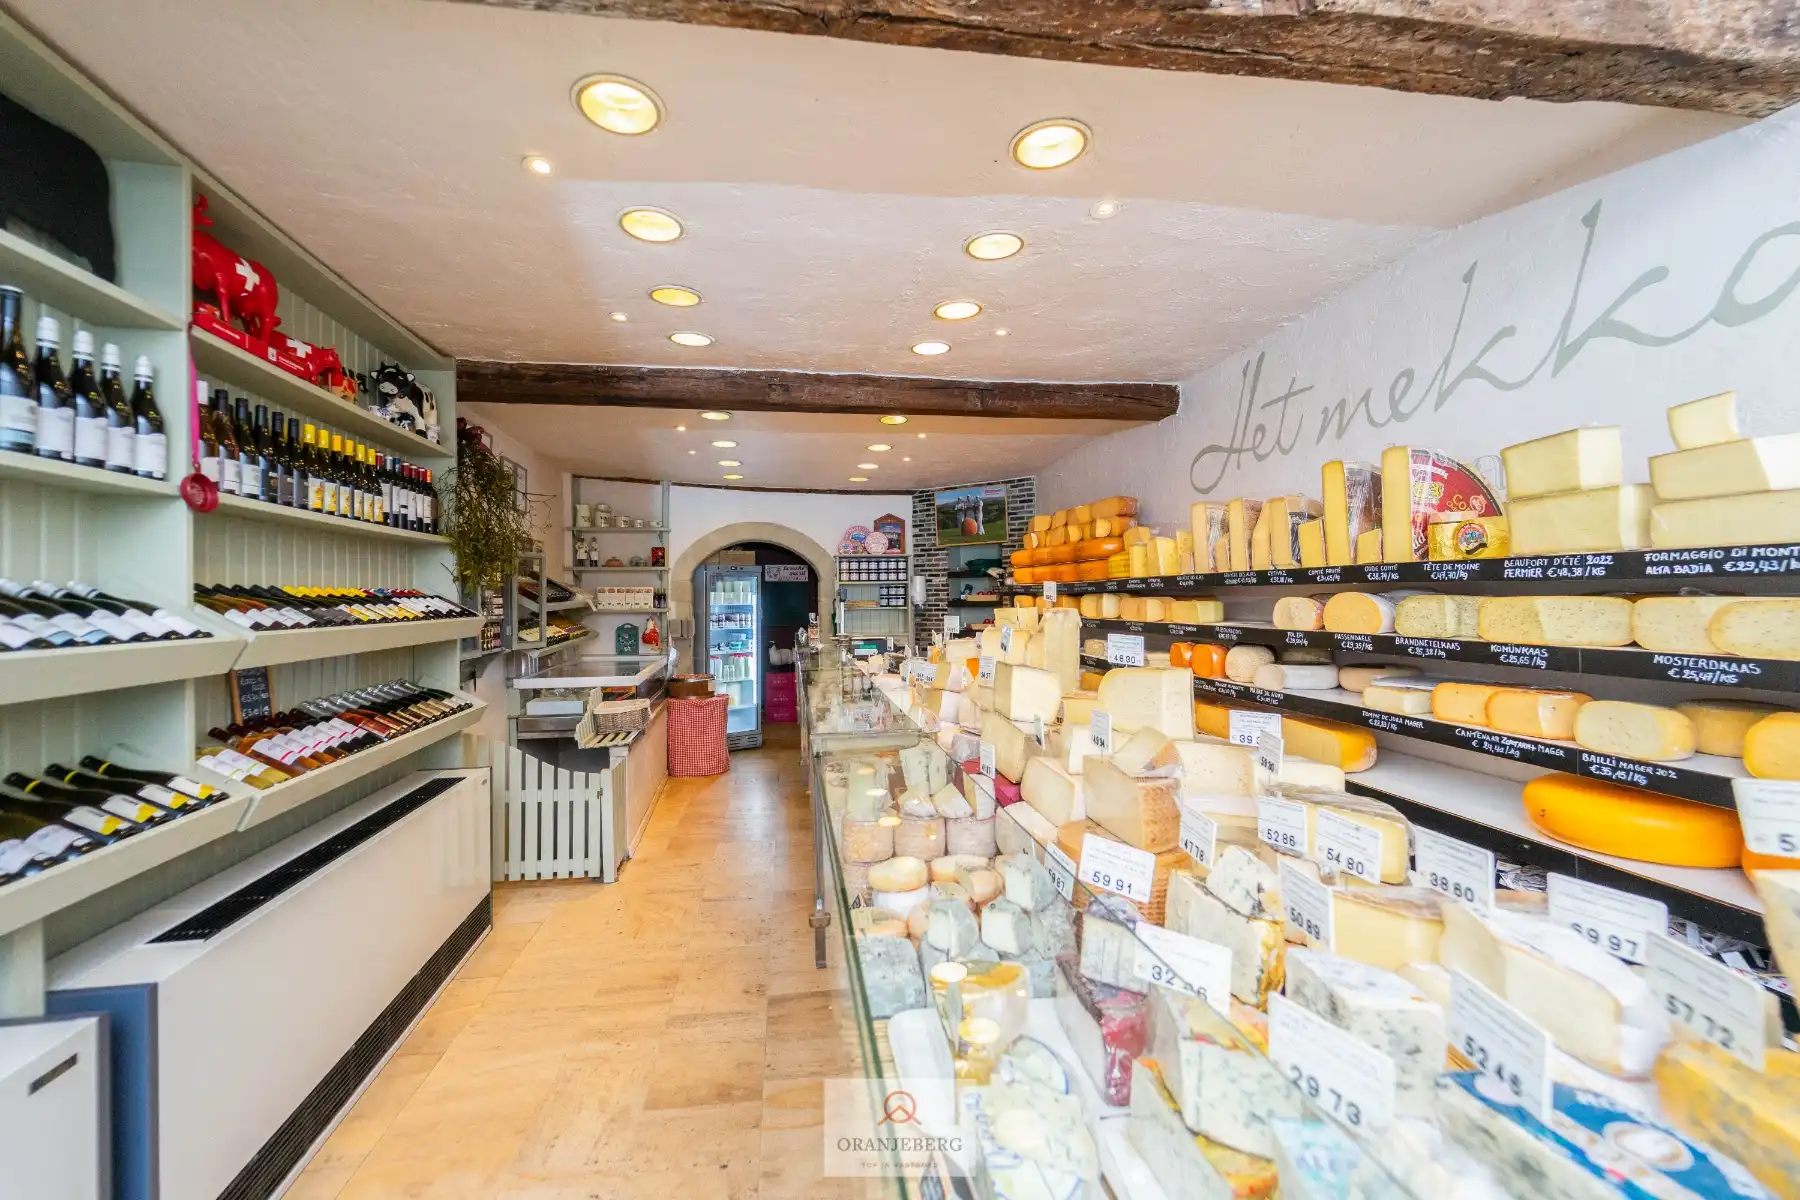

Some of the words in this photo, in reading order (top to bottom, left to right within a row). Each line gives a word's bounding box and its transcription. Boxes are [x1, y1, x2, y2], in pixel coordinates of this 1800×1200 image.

[1644, 549, 1724, 561] FORMAGGIO
[1423, 562, 1441, 571] TÊTE
[1442, 563, 1454, 571] DE
[1454, 561, 1480, 571] MOINE
[1504, 558, 1549, 567] BEAUFORT
[1504, 566, 1543, 578] FERMIER
[1645, 565, 1671, 575] ALTA
[1395, 637, 1461, 651] BRANDNETELKAAS
[1653, 654, 1761, 675] MOSTERDKAAS
[1537, 743, 1564, 758] MAGER
[1619, 760, 1654, 776] MAGER
